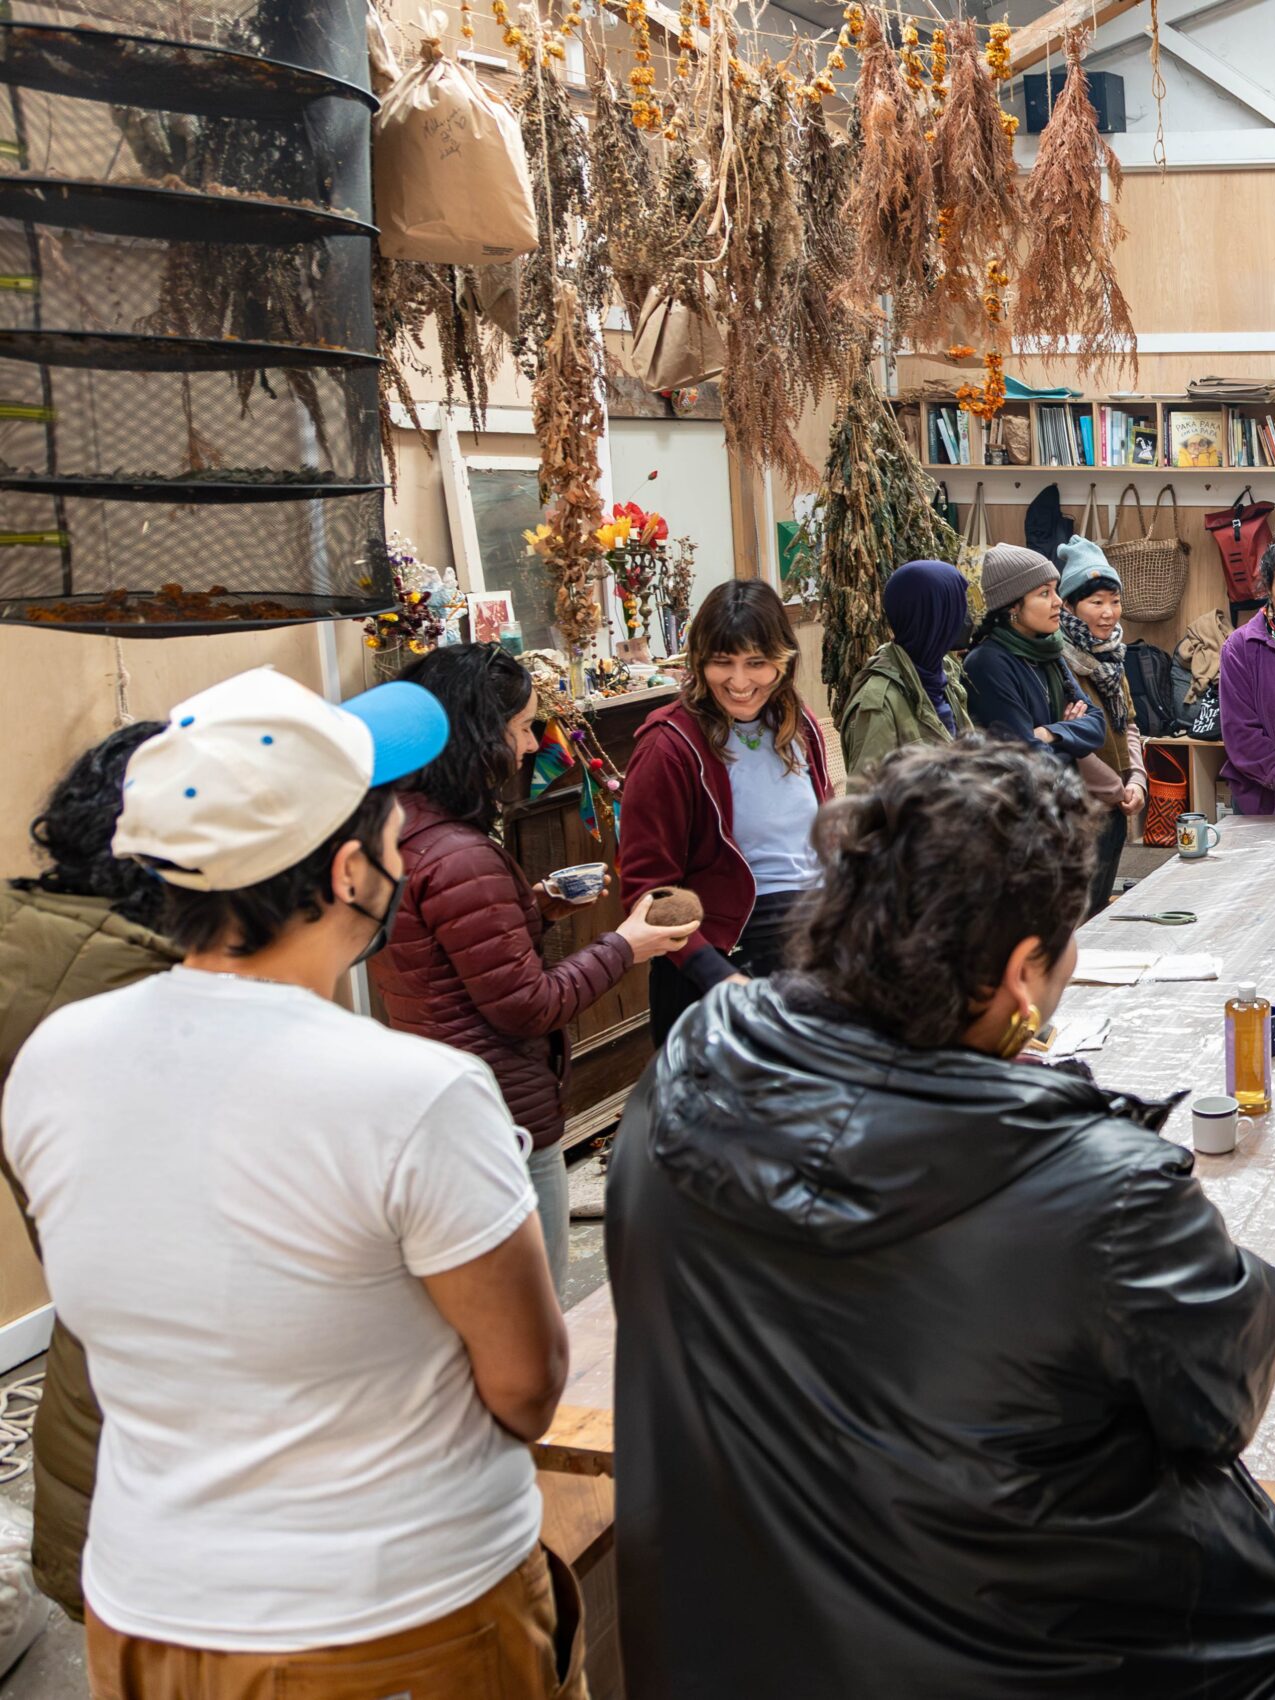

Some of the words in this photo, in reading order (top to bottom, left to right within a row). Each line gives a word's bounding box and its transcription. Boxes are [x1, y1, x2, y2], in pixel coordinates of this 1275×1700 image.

[1176, 421, 1197, 432] PAKA
[1200, 420, 1221, 431] PAKA
[1200, 428, 1217, 438] PAPA
